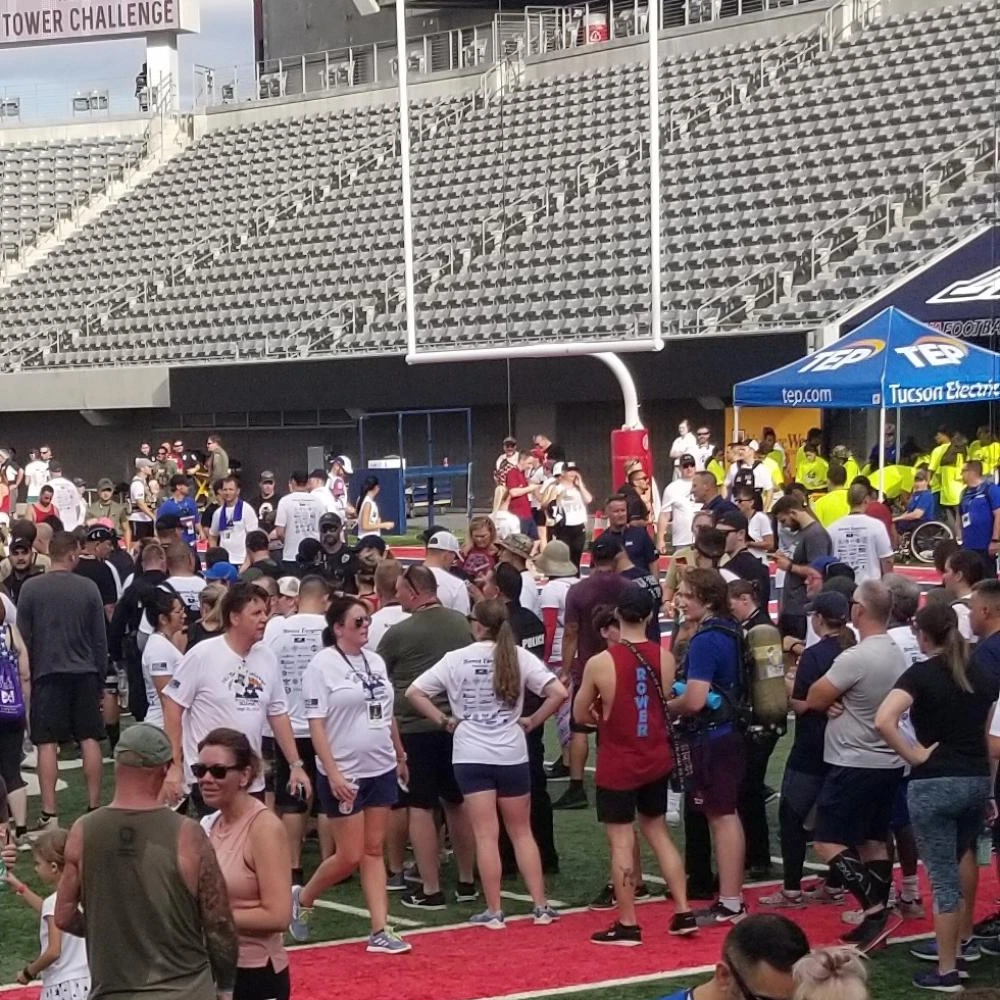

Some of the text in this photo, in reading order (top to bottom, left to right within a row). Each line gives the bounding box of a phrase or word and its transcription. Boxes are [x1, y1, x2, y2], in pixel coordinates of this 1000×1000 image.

[2, 0, 174, 37] TOWER CHALLENGE
[798, 348, 873, 373] TEP
[895, 343, 965, 368] TEP
[782, 387, 832, 407] tep.com
[889, 383, 943, 405] Tucson
[634, 667, 650, 737] ROWER
